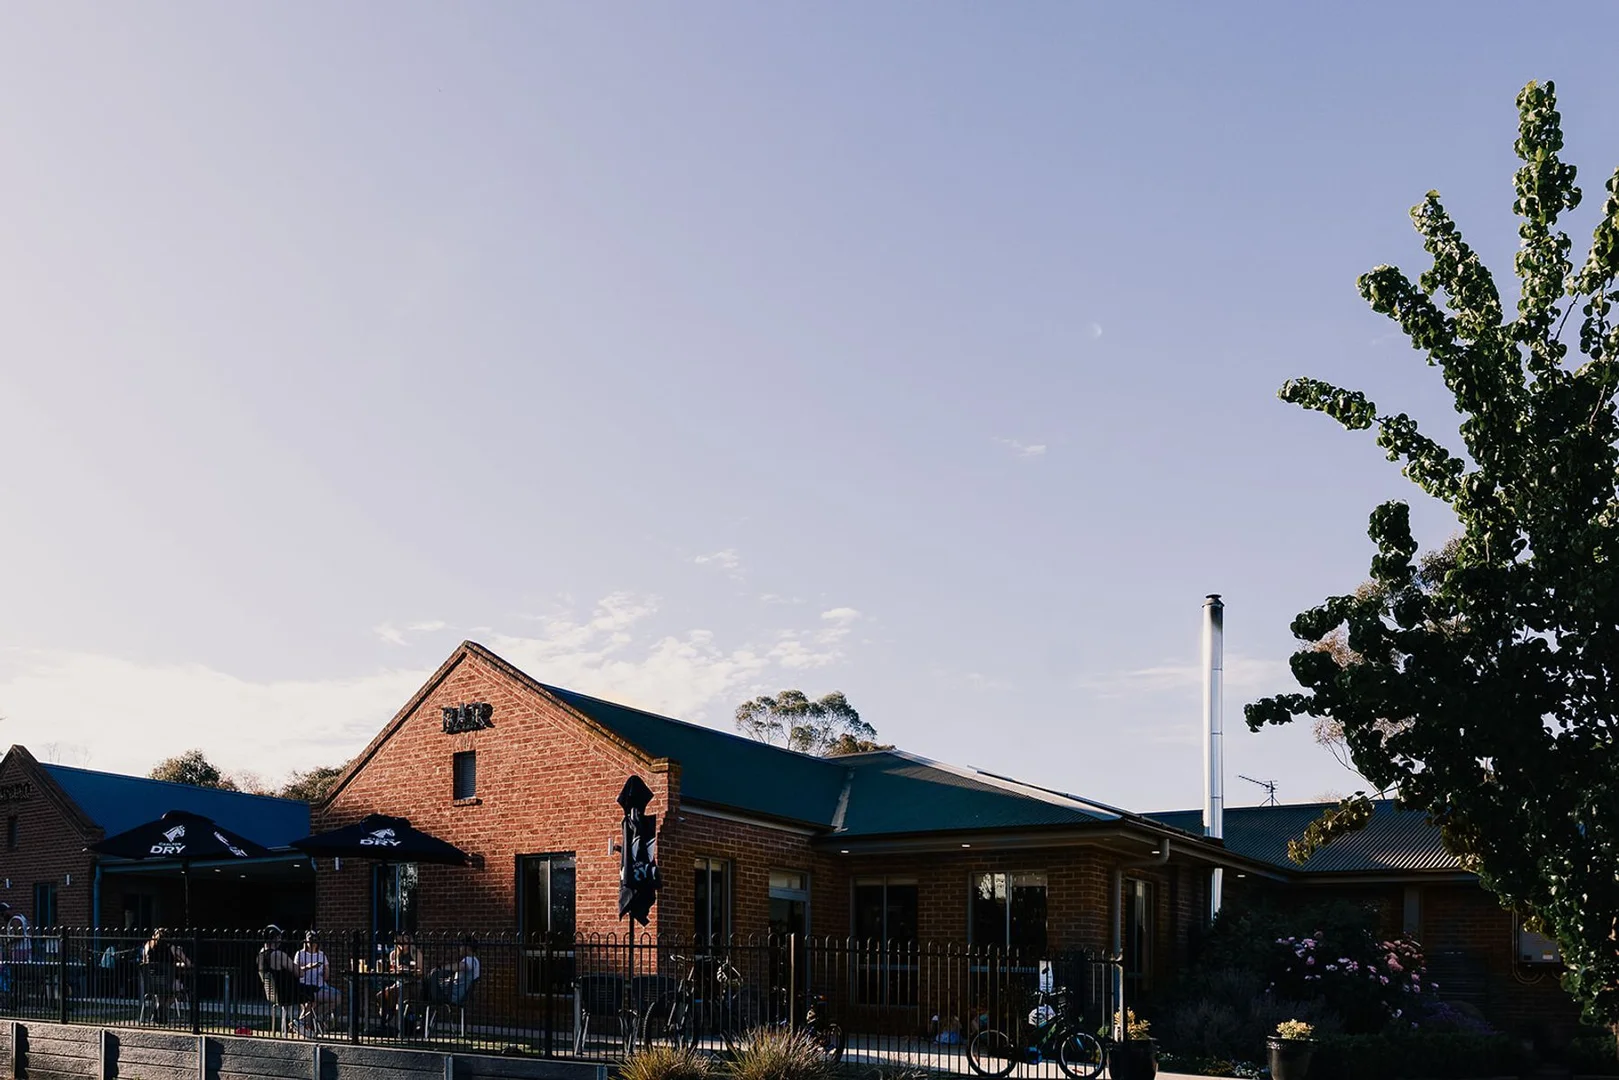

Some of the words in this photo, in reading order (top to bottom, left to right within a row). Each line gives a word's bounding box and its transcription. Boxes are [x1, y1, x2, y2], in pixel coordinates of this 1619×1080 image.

[442, 703, 495, 733] BAR
[359, 838, 402, 847] DRY
[149, 845, 187, 855] DRY
